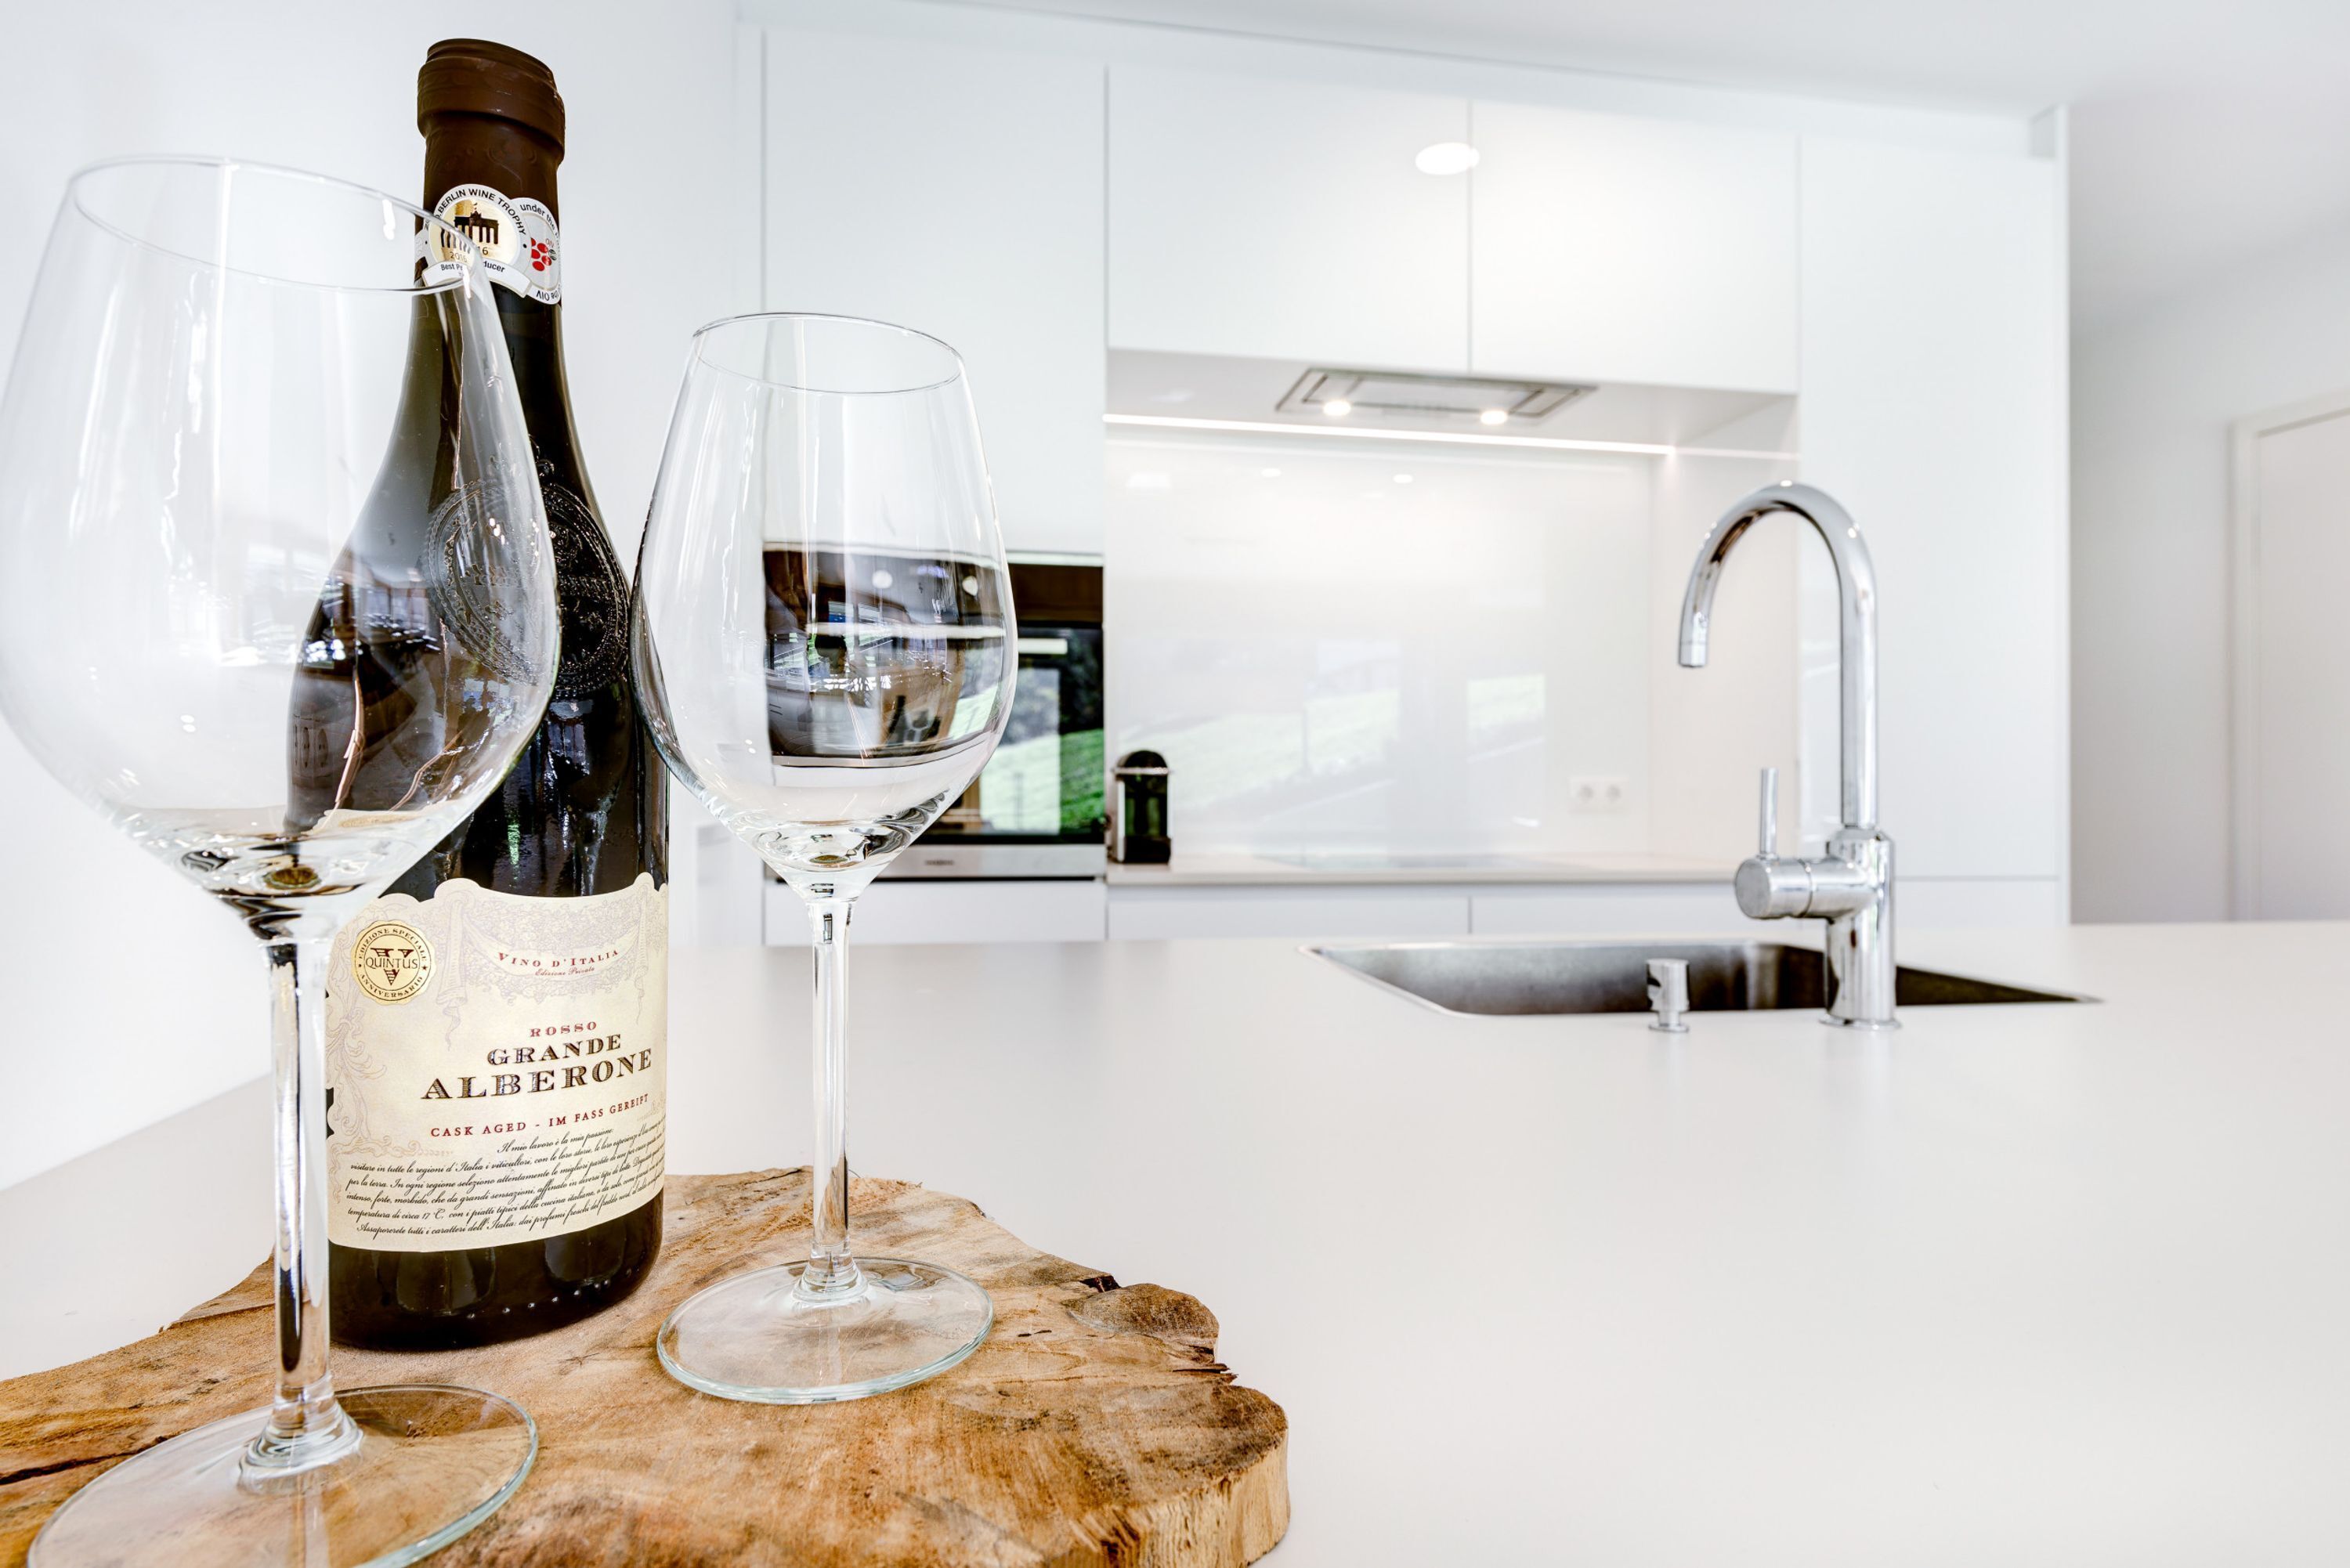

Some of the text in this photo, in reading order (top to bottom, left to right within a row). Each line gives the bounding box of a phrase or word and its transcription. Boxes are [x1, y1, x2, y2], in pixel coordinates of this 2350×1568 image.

[468, 188, 496, 201] WINE
[497, 197, 526, 235] TROPHY
[520, 204, 544, 216] under
[440, 262, 455, 271] Best
[358, 927, 428, 962] EDIZIONE SPECIALE
[365, 956, 418, 970] QUINTUS
[535, 966, 595, 976] Edizione Privata
[360, 974, 423, 999] ANNIVERSARIO
[529, 1021, 598, 1038] ROSSO
[486, 1033, 622, 1066] GRANDE
[421, 1047, 653, 1100] ALBERONE
[430, 1125, 474, 1137] CASK
[483, 1121, 527, 1135] AGED
[548, 1116, 567, 1128] IM
[574, 1107, 604, 1123] FASS
[609, 1093, 649, 1115] GEREIFT
[511, 1143, 528, 1152] mio
[529, 1136, 554, 1150] lavoro
[561, 1131, 570, 1145] la
[569, 1134, 584, 1143] mia
[350, 1162, 375, 1172] visitare
[377, 1164, 385, 1172] in
[387, 1164, 405, 1173] tutte
[406, 1160, 417, 1173] le
[415, 1165, 446, 1181] regioni
[490, 1153, 533, 1169] viticultori,
[533, 1156, 548, 1165] con
[549, 1147, 560, 1162] le
[558, 1146, 573, 1160] loro
[594, 1138, 602, 1152] le
[601, 1136, 613, 1150] loro
[345, 1177, 360, 1191] per
[360, 1173, 370, 1187] la
[389, 1178, 403, 1189] In
[403, 1180, 425, 1197] ogni
[426, 1180, 456, 1197] regione
[457, 1172, 495, 1194] seleziono
[496, 1171, 549, 1184] attentamente
[551, 1162, 561, 1176] le
[560, 1157, 588, 1181] migliori
[346, 1191, 373, 1202] intenso,
[371, 1190, 392, 1210] forte,
[394, 1190, 428, 1205] morbido,
[431, 1190, 446, 1204] che
[446, 1192, 458, 1203] da
[454, 1189, 489, 1211] grandi
[490, 1186, 535, 1205] sensazioni,
[535, 1178, 568, 1201] affinato
[347, 1207, 390, 1223] temperatura
[392, 1209, 401, 1219] di
[401, 1211, 419, 1220] circa
[466, 1209, 494, 1225] piatti
[496, 1204, 518, 1222] tipici
[519, 1198, 539, 1212] della
[540, 1193, 566, 1207] cucina
[567, 1186, 595, 1205] italiana,
[356, 1222, 406, 1241] Assaporerete
[407, 1225, 424, 1235] tutti
[431, 1223, 466, 1235] caratteri
[519, 1214, 534, 1226] dai
[529, 1207, 566, 1232] profumi
[562, 1198, 590, 1226] freschi
